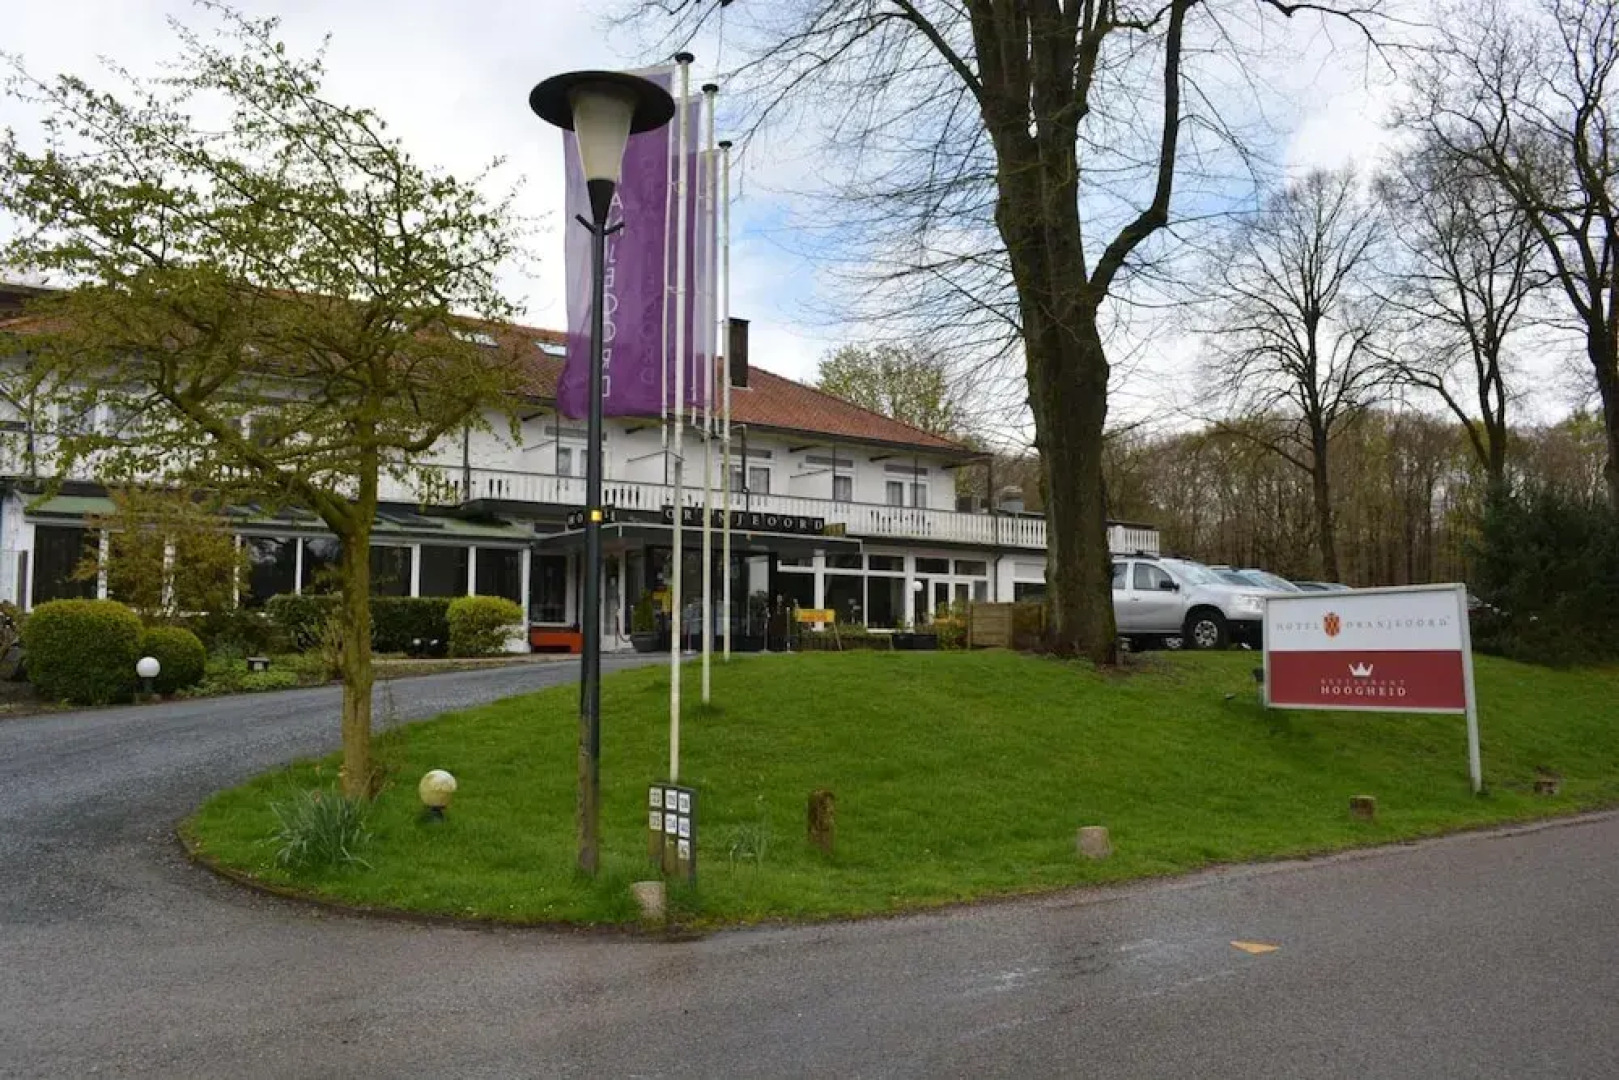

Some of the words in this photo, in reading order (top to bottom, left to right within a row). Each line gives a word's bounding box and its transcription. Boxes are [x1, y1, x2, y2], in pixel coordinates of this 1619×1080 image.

[665, 509, 823, 531] ORNJEOORD
[1276, 622, 1319, 631] HOTEL
[1320, 685, 1406, 697] HOOGHEID
